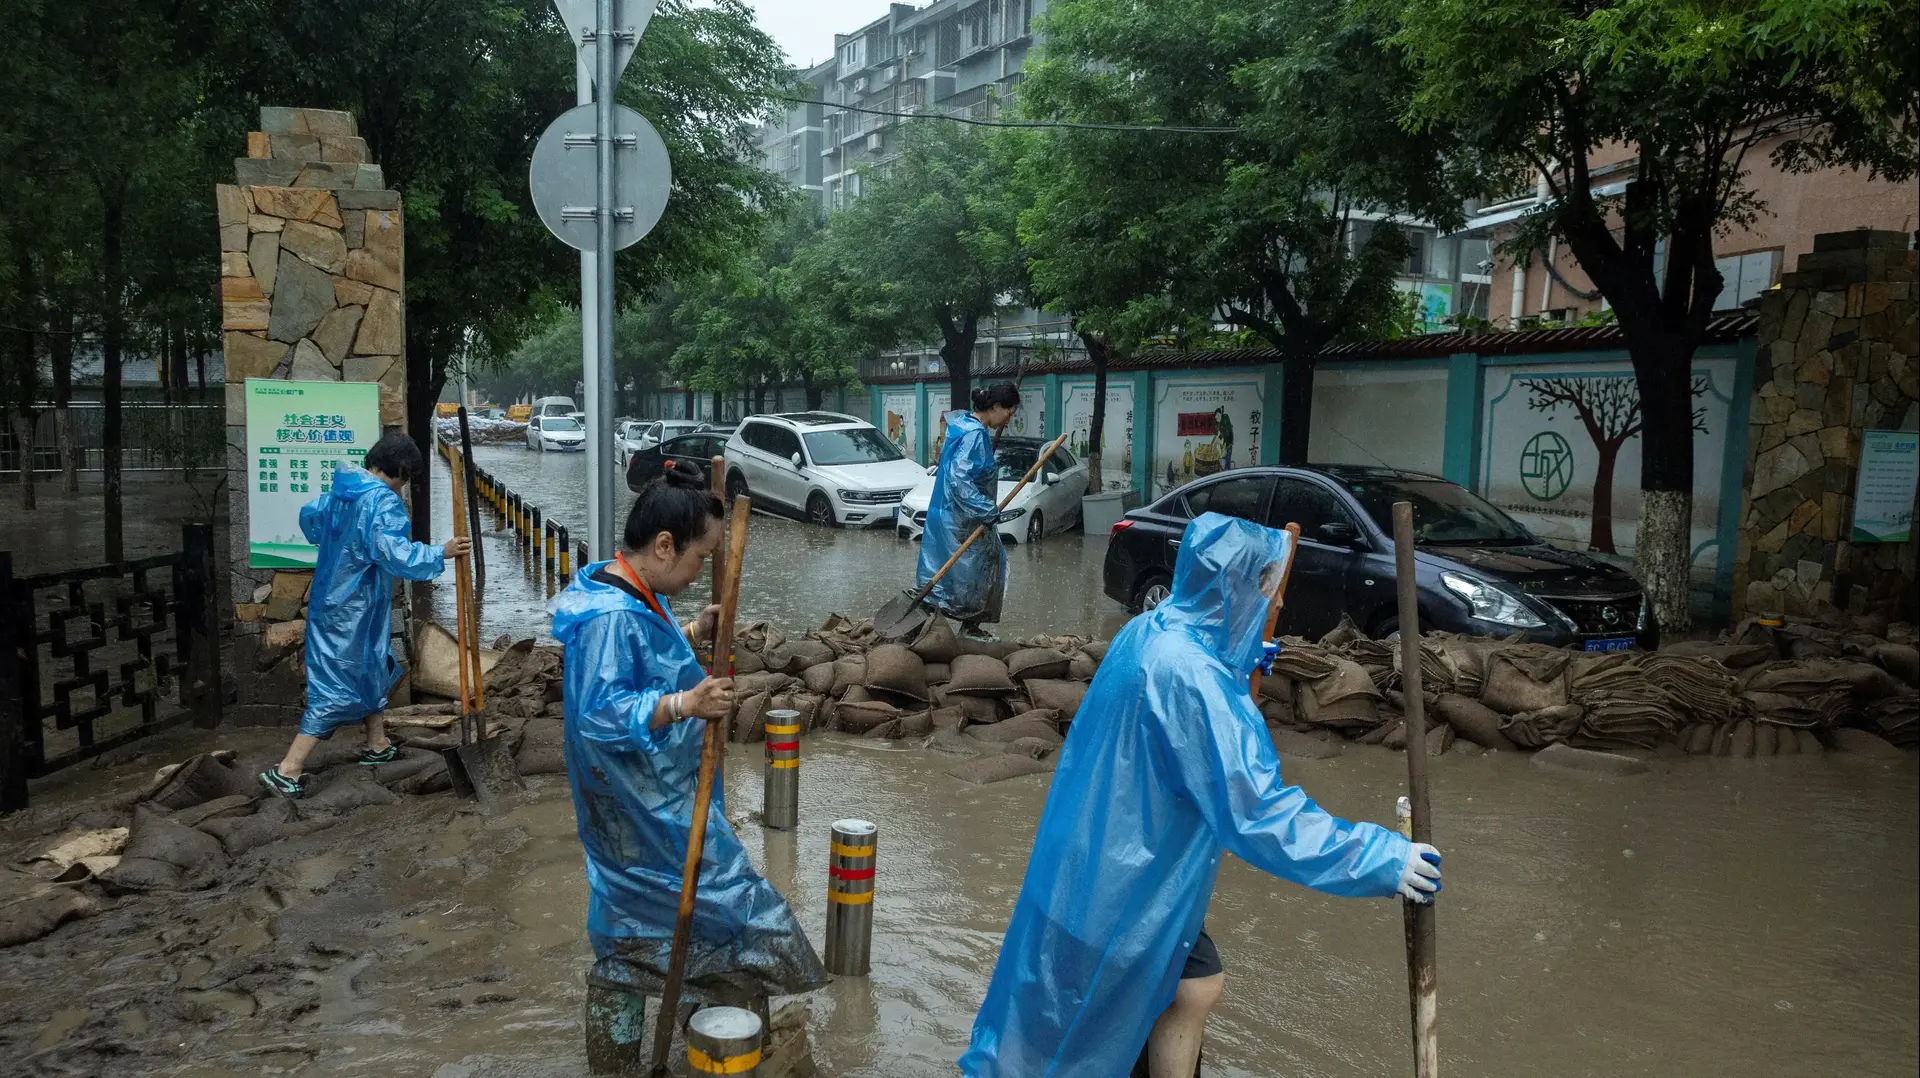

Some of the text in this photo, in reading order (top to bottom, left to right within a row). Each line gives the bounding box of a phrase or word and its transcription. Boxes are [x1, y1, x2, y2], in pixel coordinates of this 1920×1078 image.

[284, 413, 345, 427] 社会主义
[276, 428, 353, 443] 核心价值观
[290, 460, 308, 469] 民主
[259, 471, 278, 481] 自由
[290, 471, 309, 481] 平等
[290, 483, 309, 493] 敬业
